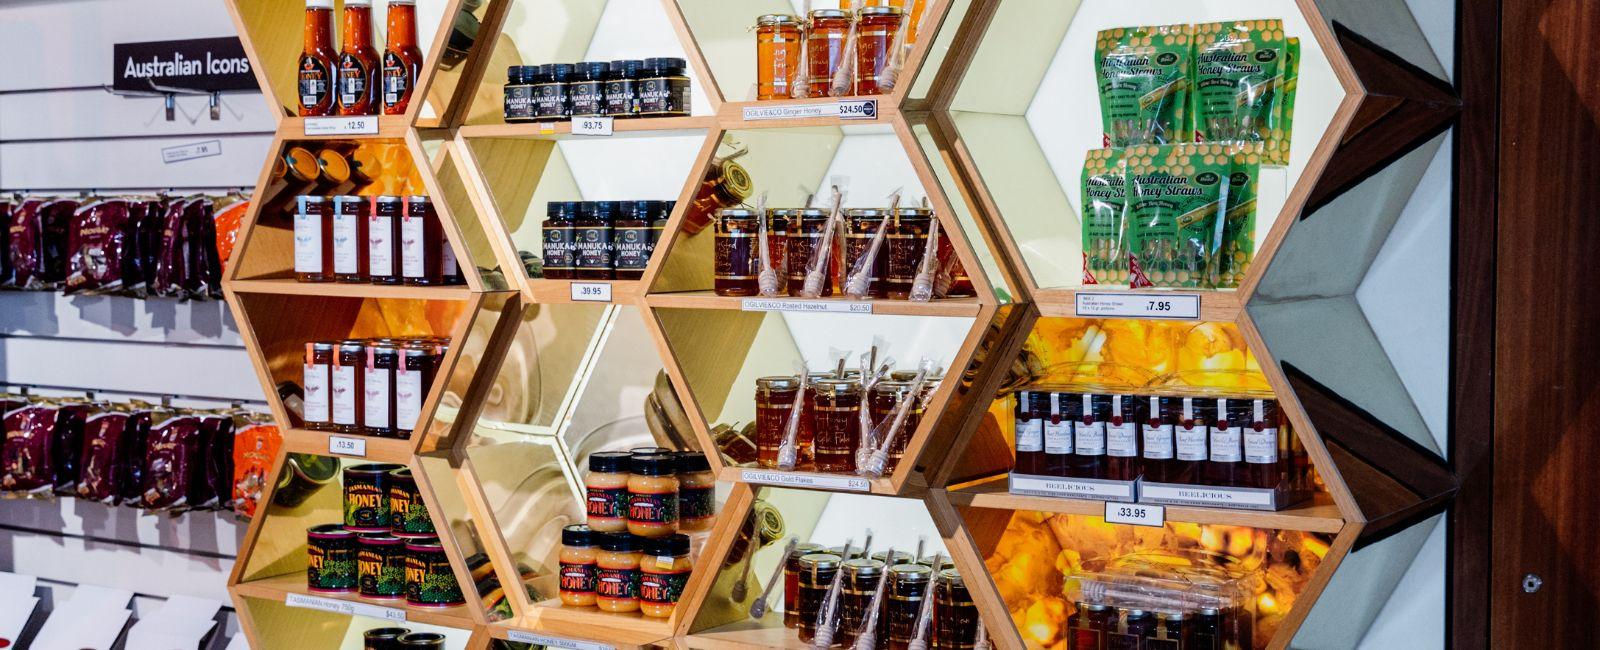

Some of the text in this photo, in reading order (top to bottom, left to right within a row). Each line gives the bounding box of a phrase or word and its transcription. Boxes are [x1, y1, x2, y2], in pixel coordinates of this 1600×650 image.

[1198, 52, 1248, 65] Australian
[124, 52, 250, 78] Australian Icons
[1198, 63, 1262, 77] Honey Straws
[803, 105, 822, 115] Honey
[840, 103, 864, 114] $24.50
[1132, 174, 1188, 187] Australian
[1133, 186, 1162, 200] Honey
[1164, 184, 1203, 197] Straws
[544, 242, 570, 250] MANUKA
[578, 242, 607, 250] MANUKA
[616, 243, 647, 251] MANUKA
[850, 304, 870, 312] $20.50
[349, 484, 382, 493] TASMANIAN
[848, 479, 868, 488] $24.50
[1046, 482, 1095, 491] BEELICIOUS
[349, 493, 383, 508] HONEY
[1177, 490, 1233, 500] BEELICIOUS
[630, 506, 662, 519] HONEY
[561, 576, 593, 589] HONEY
[598, 580, 629, 595] HONEY
[322, 601, 340, 611] Honey
